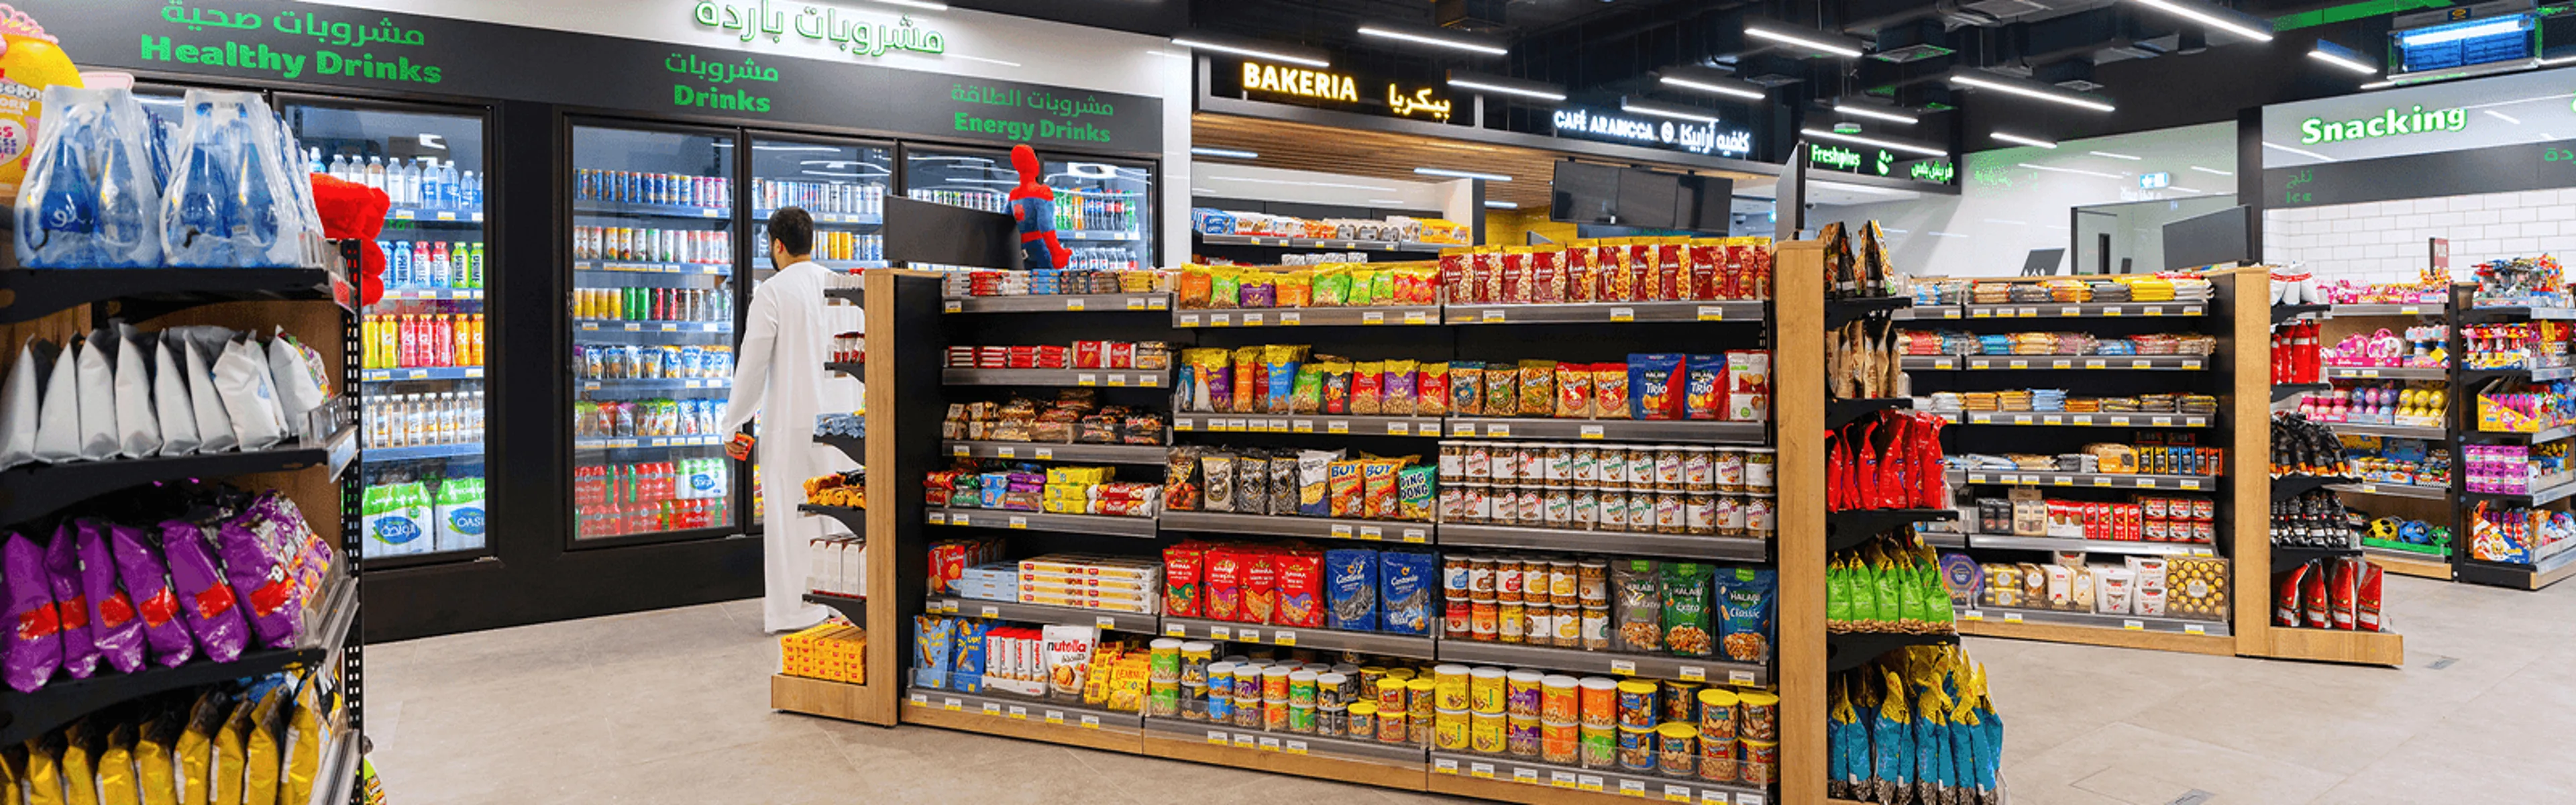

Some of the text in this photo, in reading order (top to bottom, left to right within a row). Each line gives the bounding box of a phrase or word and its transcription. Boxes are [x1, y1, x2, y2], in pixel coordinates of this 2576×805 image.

[161, 0, 425, 47] مشروبات صحية
[796, 5, 945, 58] مشروبات
[141, 34, 443, 84] Healthy Drinks
[665, 53, 780, 83] مشروبات
[674, 84, 771, 113] Drinks
[1243, 62, 1358, 103] BAKERIA
[951, 83, 1114, 119] مشروبات الطاقة
[1389, 83, 1451, 119] بيكريا
[954, 111, 1112, 144] Energy Drinks
[1554, 109, 1587, 132] CAFÉ
[2301, 105, 2469, 146] Snacking
[1811, 143, 1862, 170] Freshplus
[2286, 191, 2312, 204] Ice
[1365, 464, 1393, 477] BOY
[1046, 638, 1087, 653] nutella
